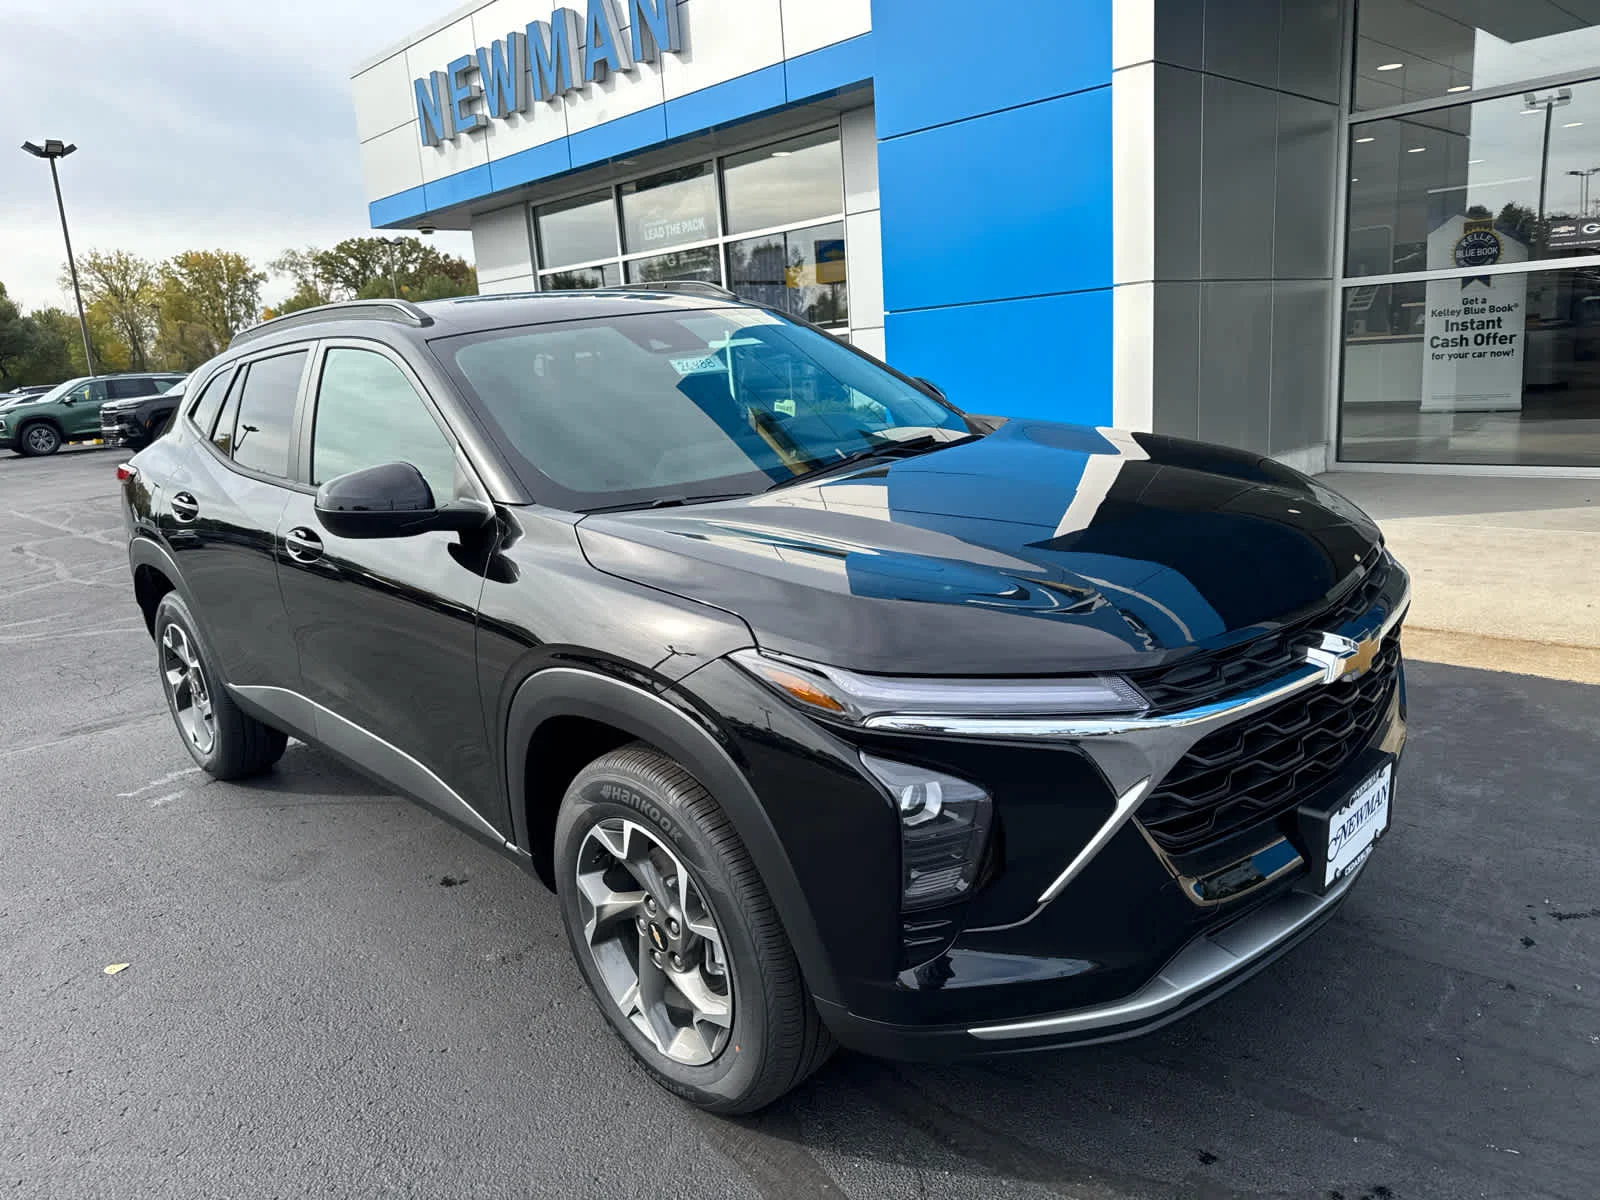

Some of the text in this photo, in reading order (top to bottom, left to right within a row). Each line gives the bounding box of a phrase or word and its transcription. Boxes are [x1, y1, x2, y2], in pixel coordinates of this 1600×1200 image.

[414, 0, 680, 147] NEWMAN
[644, 225, 664, 240] LEAD
[665, 222, 681, 239] THE
[681, 216, 705, 233] PACK
[1461, 233, 1496, 247] KELLEY
[1456, 246, 1498, 258] BLUE BOOK
[1462, 297, 1479, 305] Get
[1431, 308, 1461, 317] Kelley
[1463, 306, 1486, 315] Blue
[1445, 317, 1502, 332] Instant
[1430, 332, 1517, 348] Cash Offer
[1448, 352, 1470, 361] your
[1472, 351, 1487, 359] car
[1490, 348, 1514, 358] now!
[1329, 782, 1388, 857] NEWMAN
